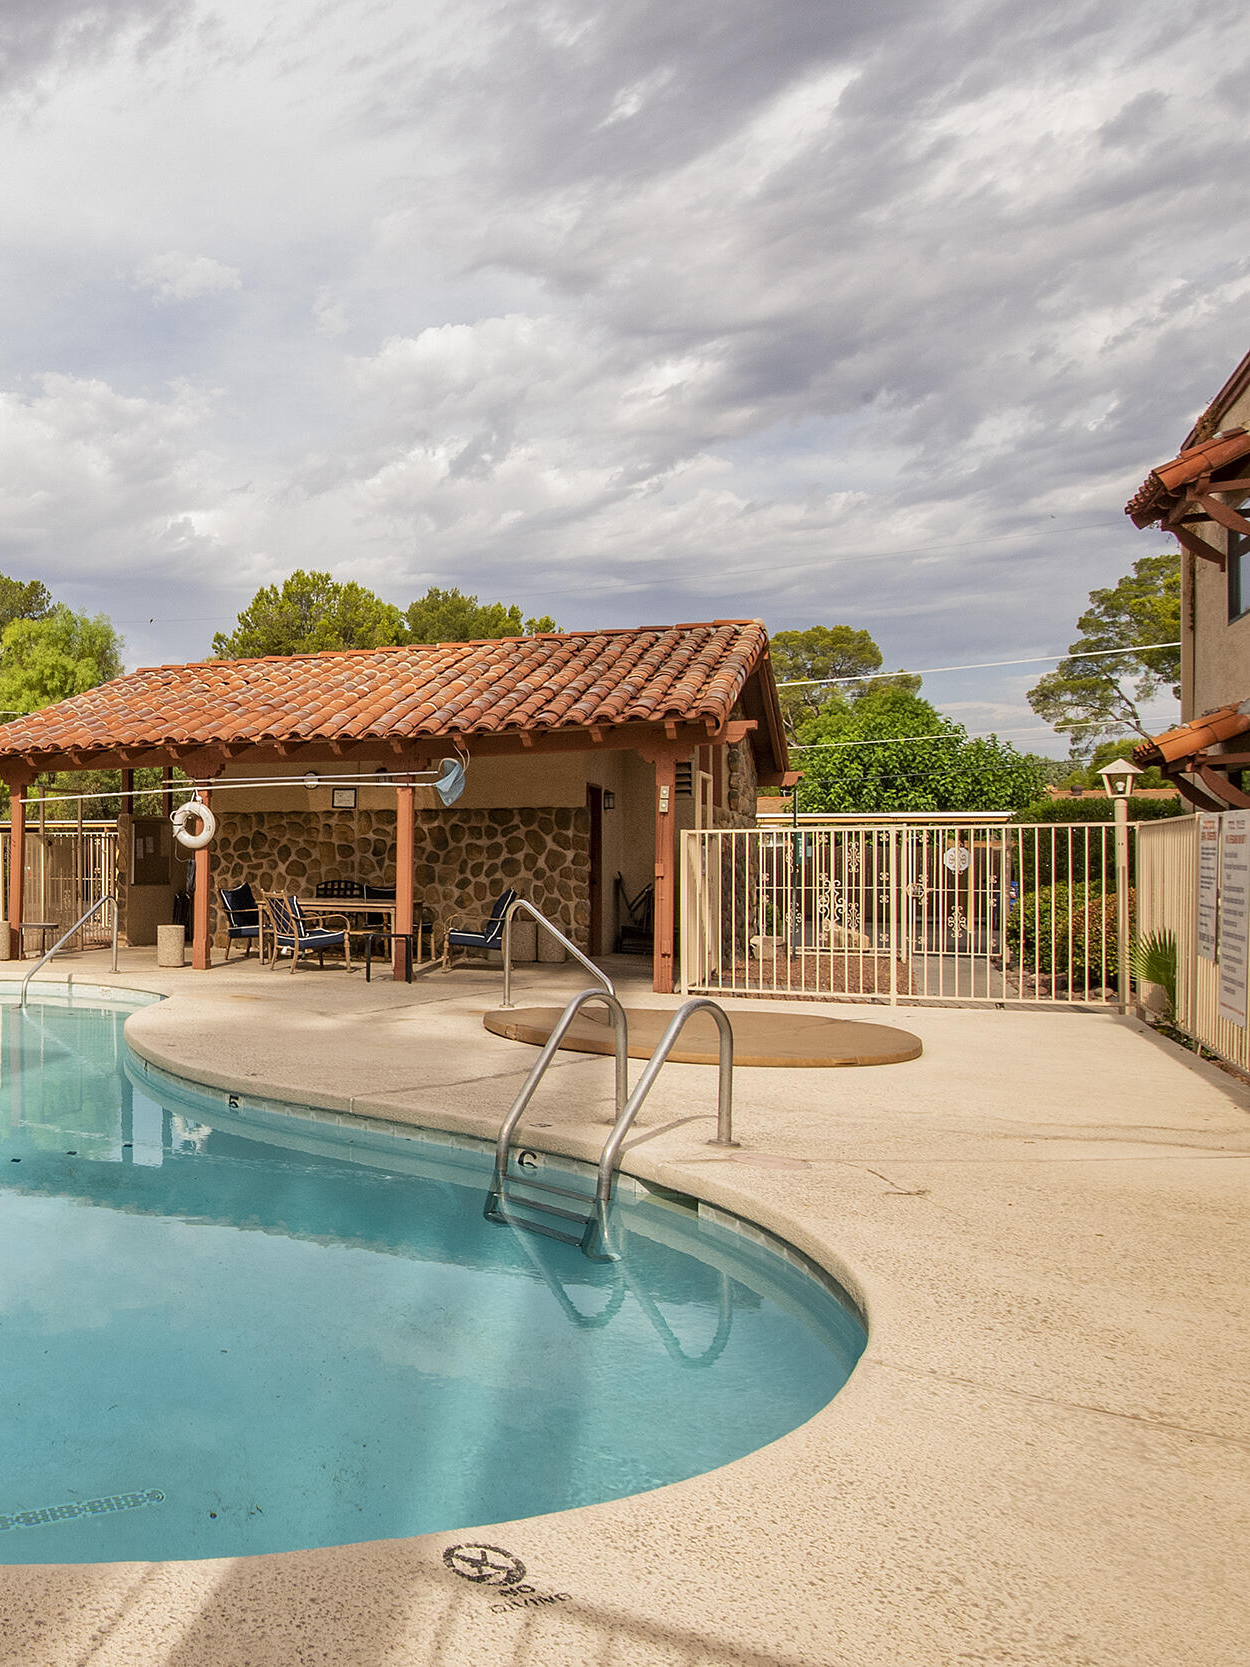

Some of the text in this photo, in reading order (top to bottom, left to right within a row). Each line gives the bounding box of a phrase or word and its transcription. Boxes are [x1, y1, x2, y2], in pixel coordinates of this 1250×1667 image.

[228, 1094, 239, 1108] 5
[517, 1150, 538, 1172] 6
[498, 1583, 536, 1597] NO
[490, 1592, 573, 1614] DIVING
